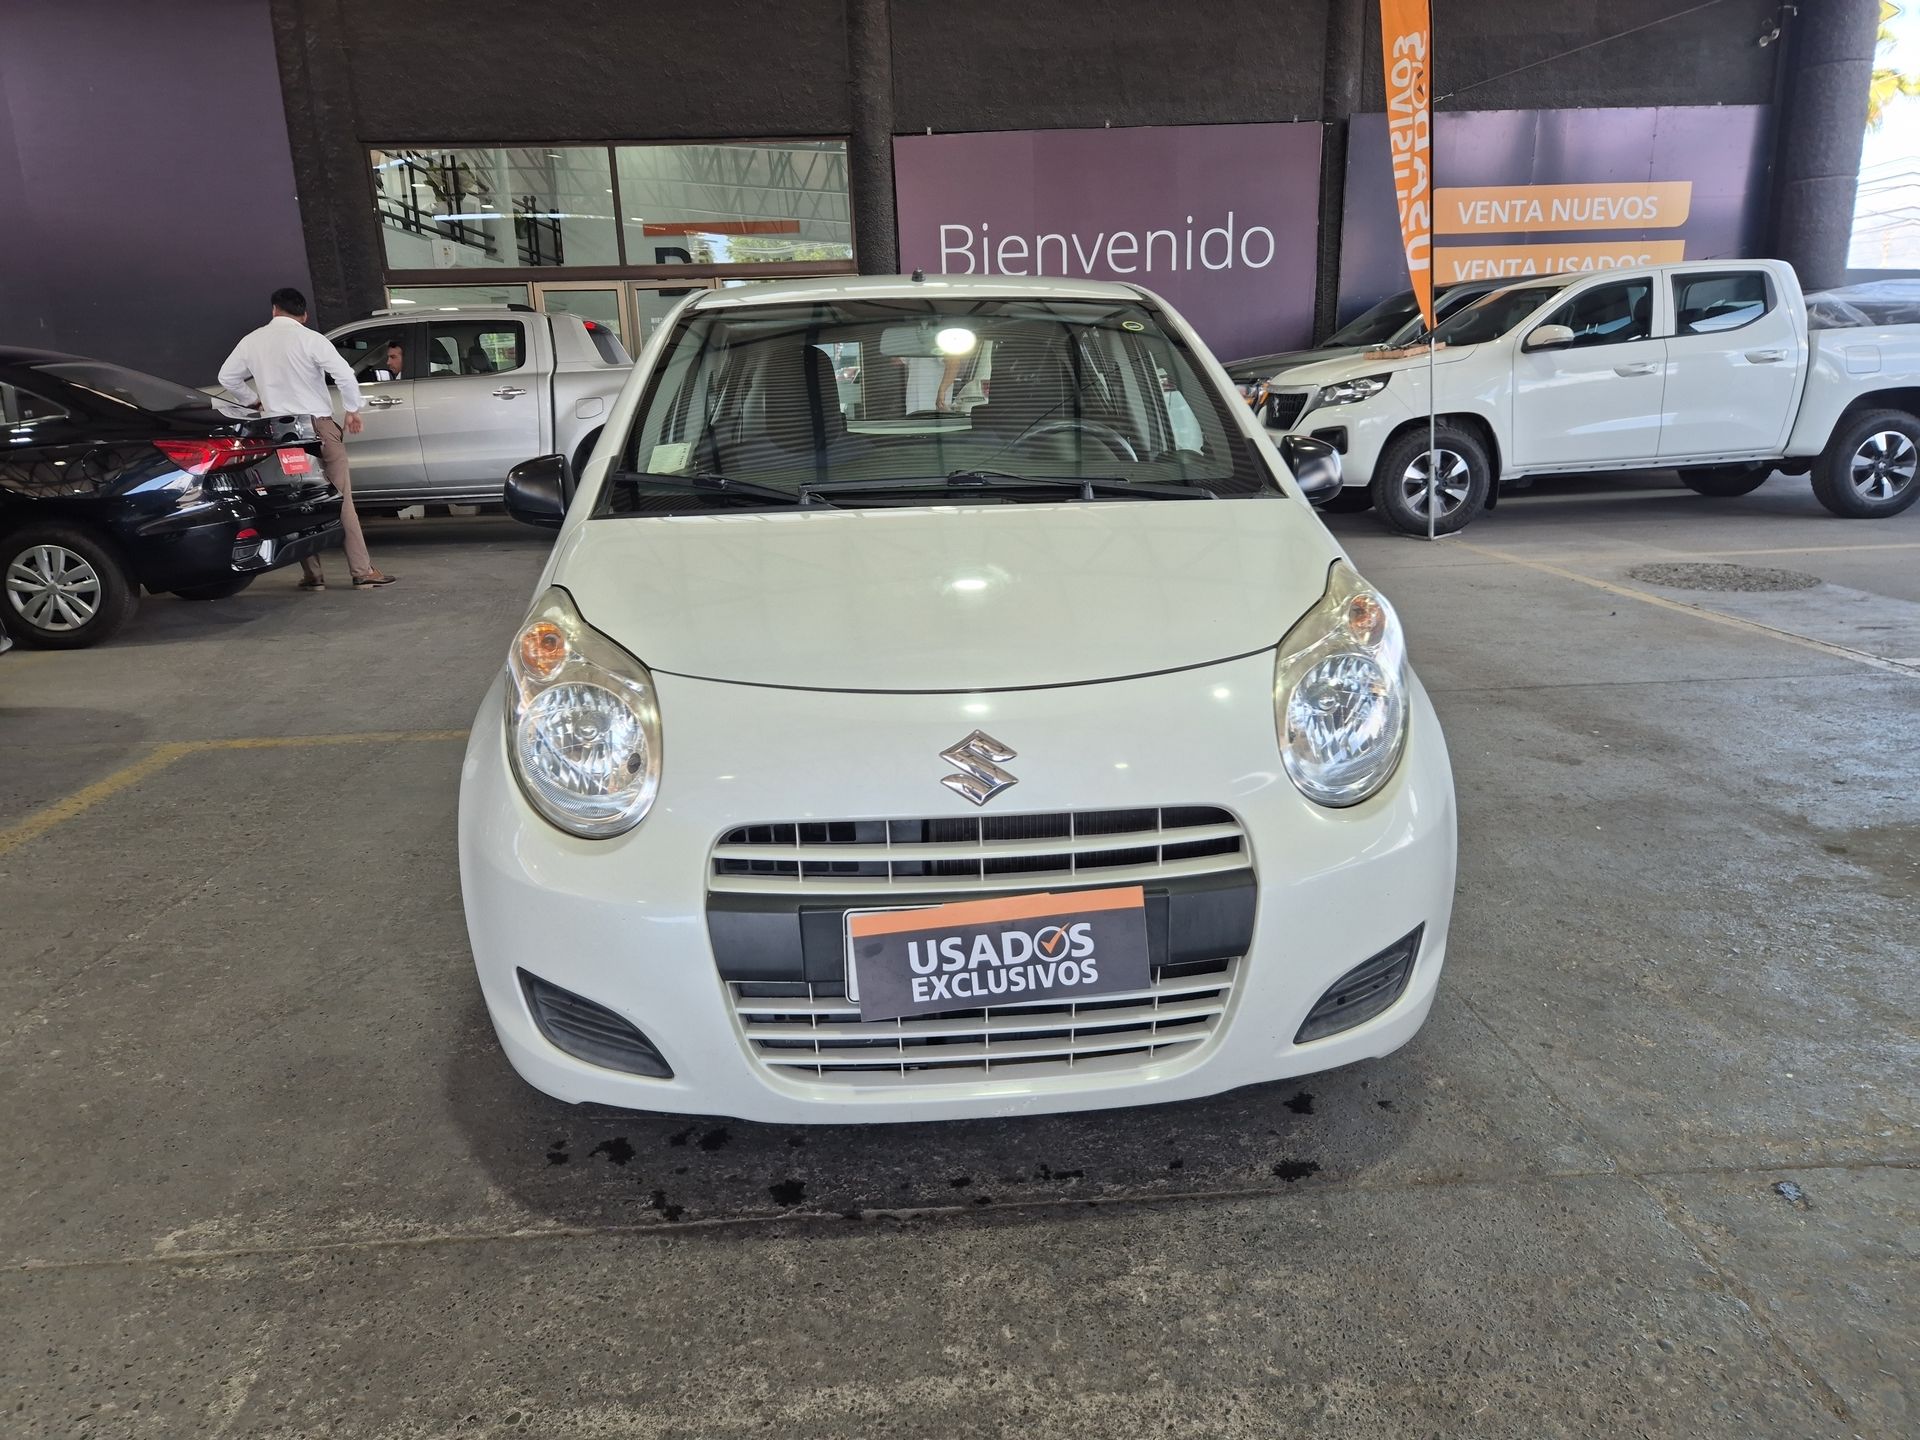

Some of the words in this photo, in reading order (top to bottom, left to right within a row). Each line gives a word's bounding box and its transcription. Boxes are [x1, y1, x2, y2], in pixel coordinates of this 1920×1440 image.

[1458, 199, 1544, 225] VENTA
[1551, 195, 1658, 222] NUEVOS
[939, 211, 1276, 276] Bienvenido
[1453, 258, 1537, 282] VENTA
[907, 922, 1096, 975] USADOS
[911, 958, 1099, 1003] EXCLUSIVOS
